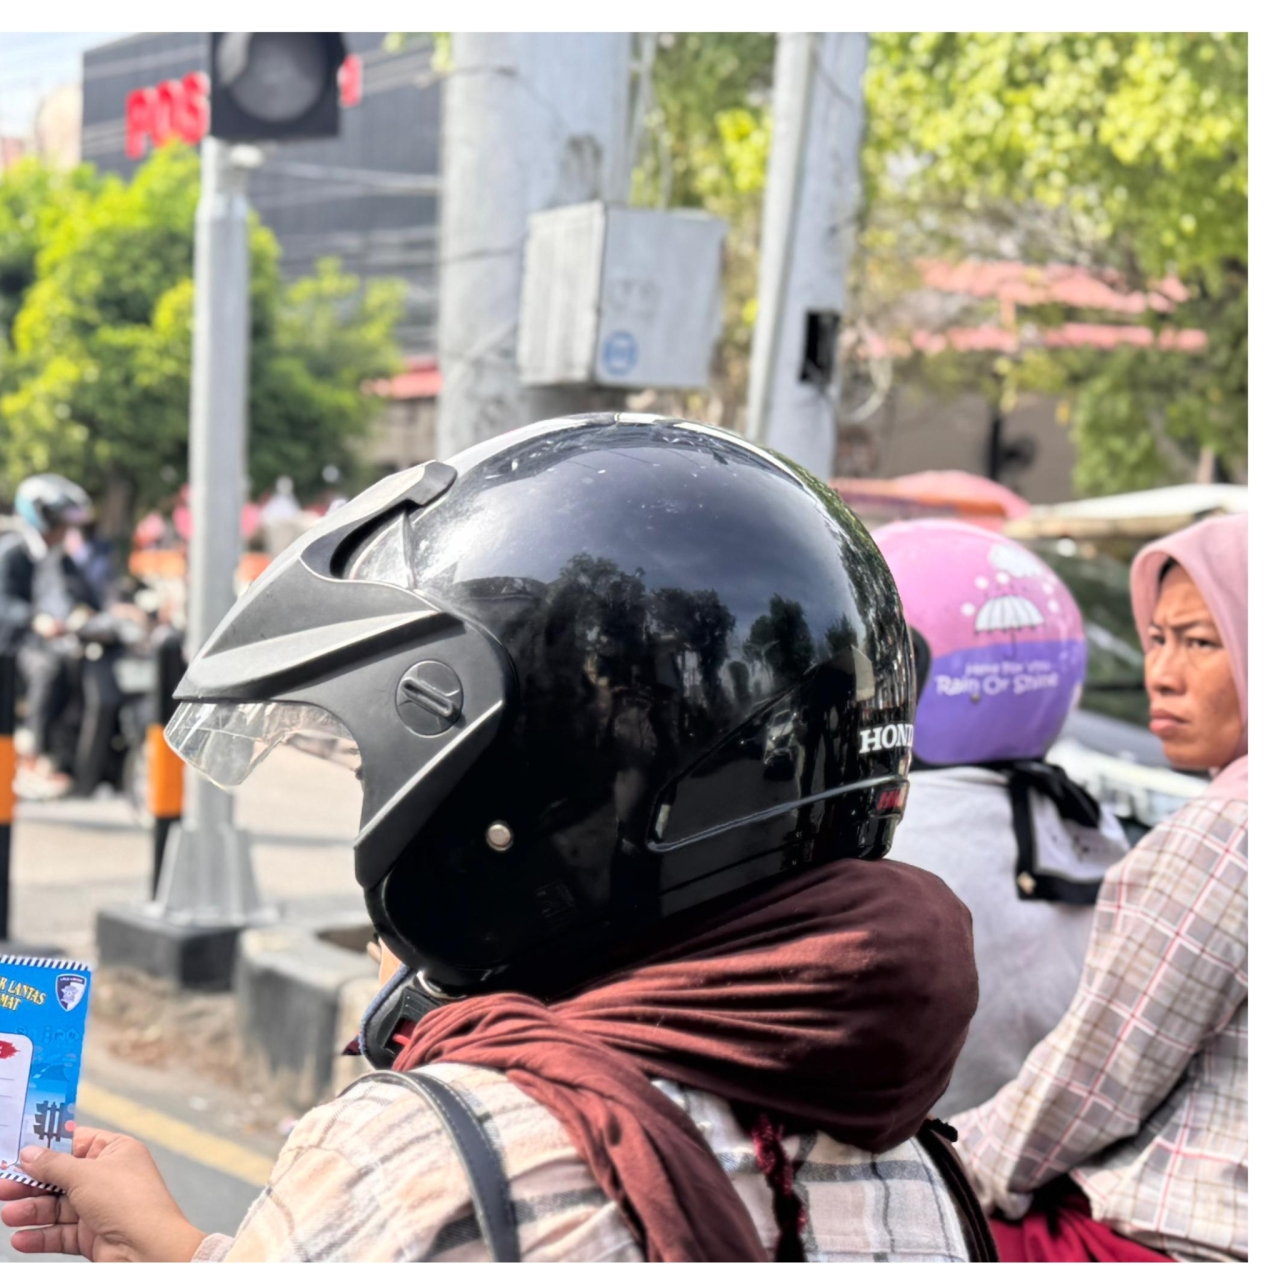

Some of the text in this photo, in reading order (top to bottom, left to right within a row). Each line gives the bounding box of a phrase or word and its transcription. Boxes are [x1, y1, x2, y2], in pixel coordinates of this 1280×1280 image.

[125, 70, 210, 160] POS
[982, 674, 1008, 696] Or
[859, 723, 915, 754] HOND
[7, 979, 47, 1006] LANTAS
